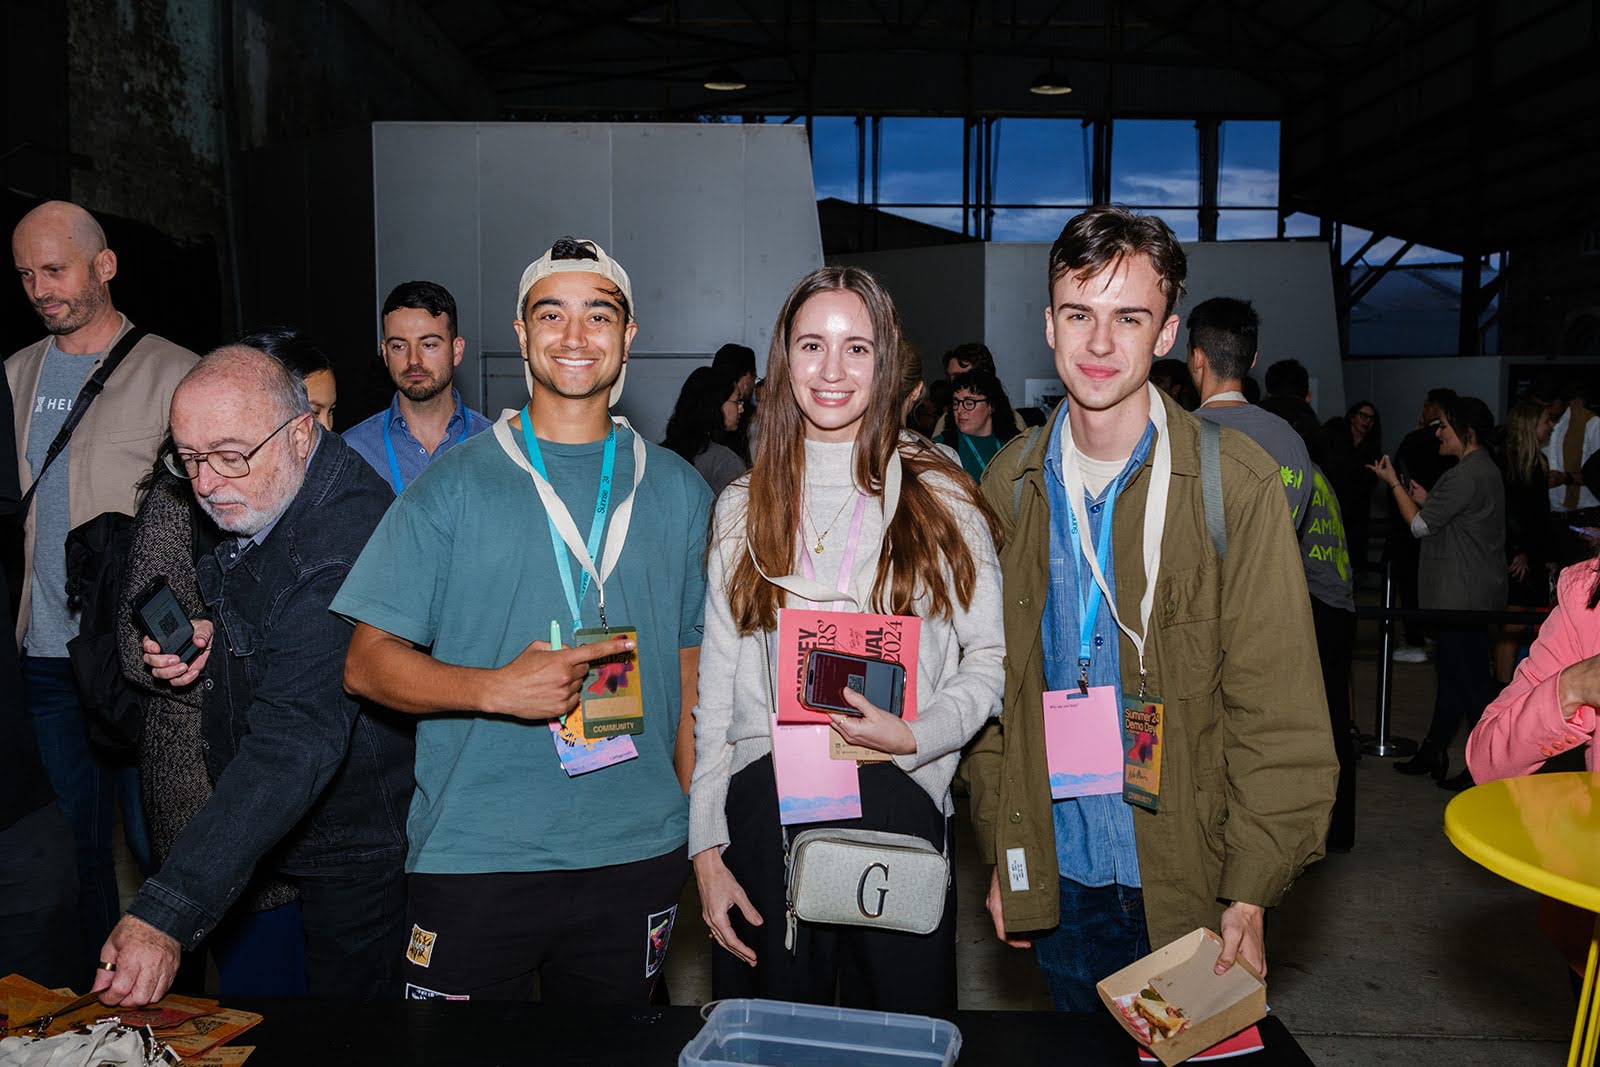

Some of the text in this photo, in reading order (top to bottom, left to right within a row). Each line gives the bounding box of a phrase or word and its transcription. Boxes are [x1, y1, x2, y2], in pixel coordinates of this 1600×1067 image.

[597, 475, 609, 514] Sunrise 24
[883, 620, 903, 663] 2024
[593, 722, 635, 733] COMMUNITY
[1125, 718, 1144, 731] Demo
[1144, 721, 1157, 737] Day
[856, 862, 890, 920] G
